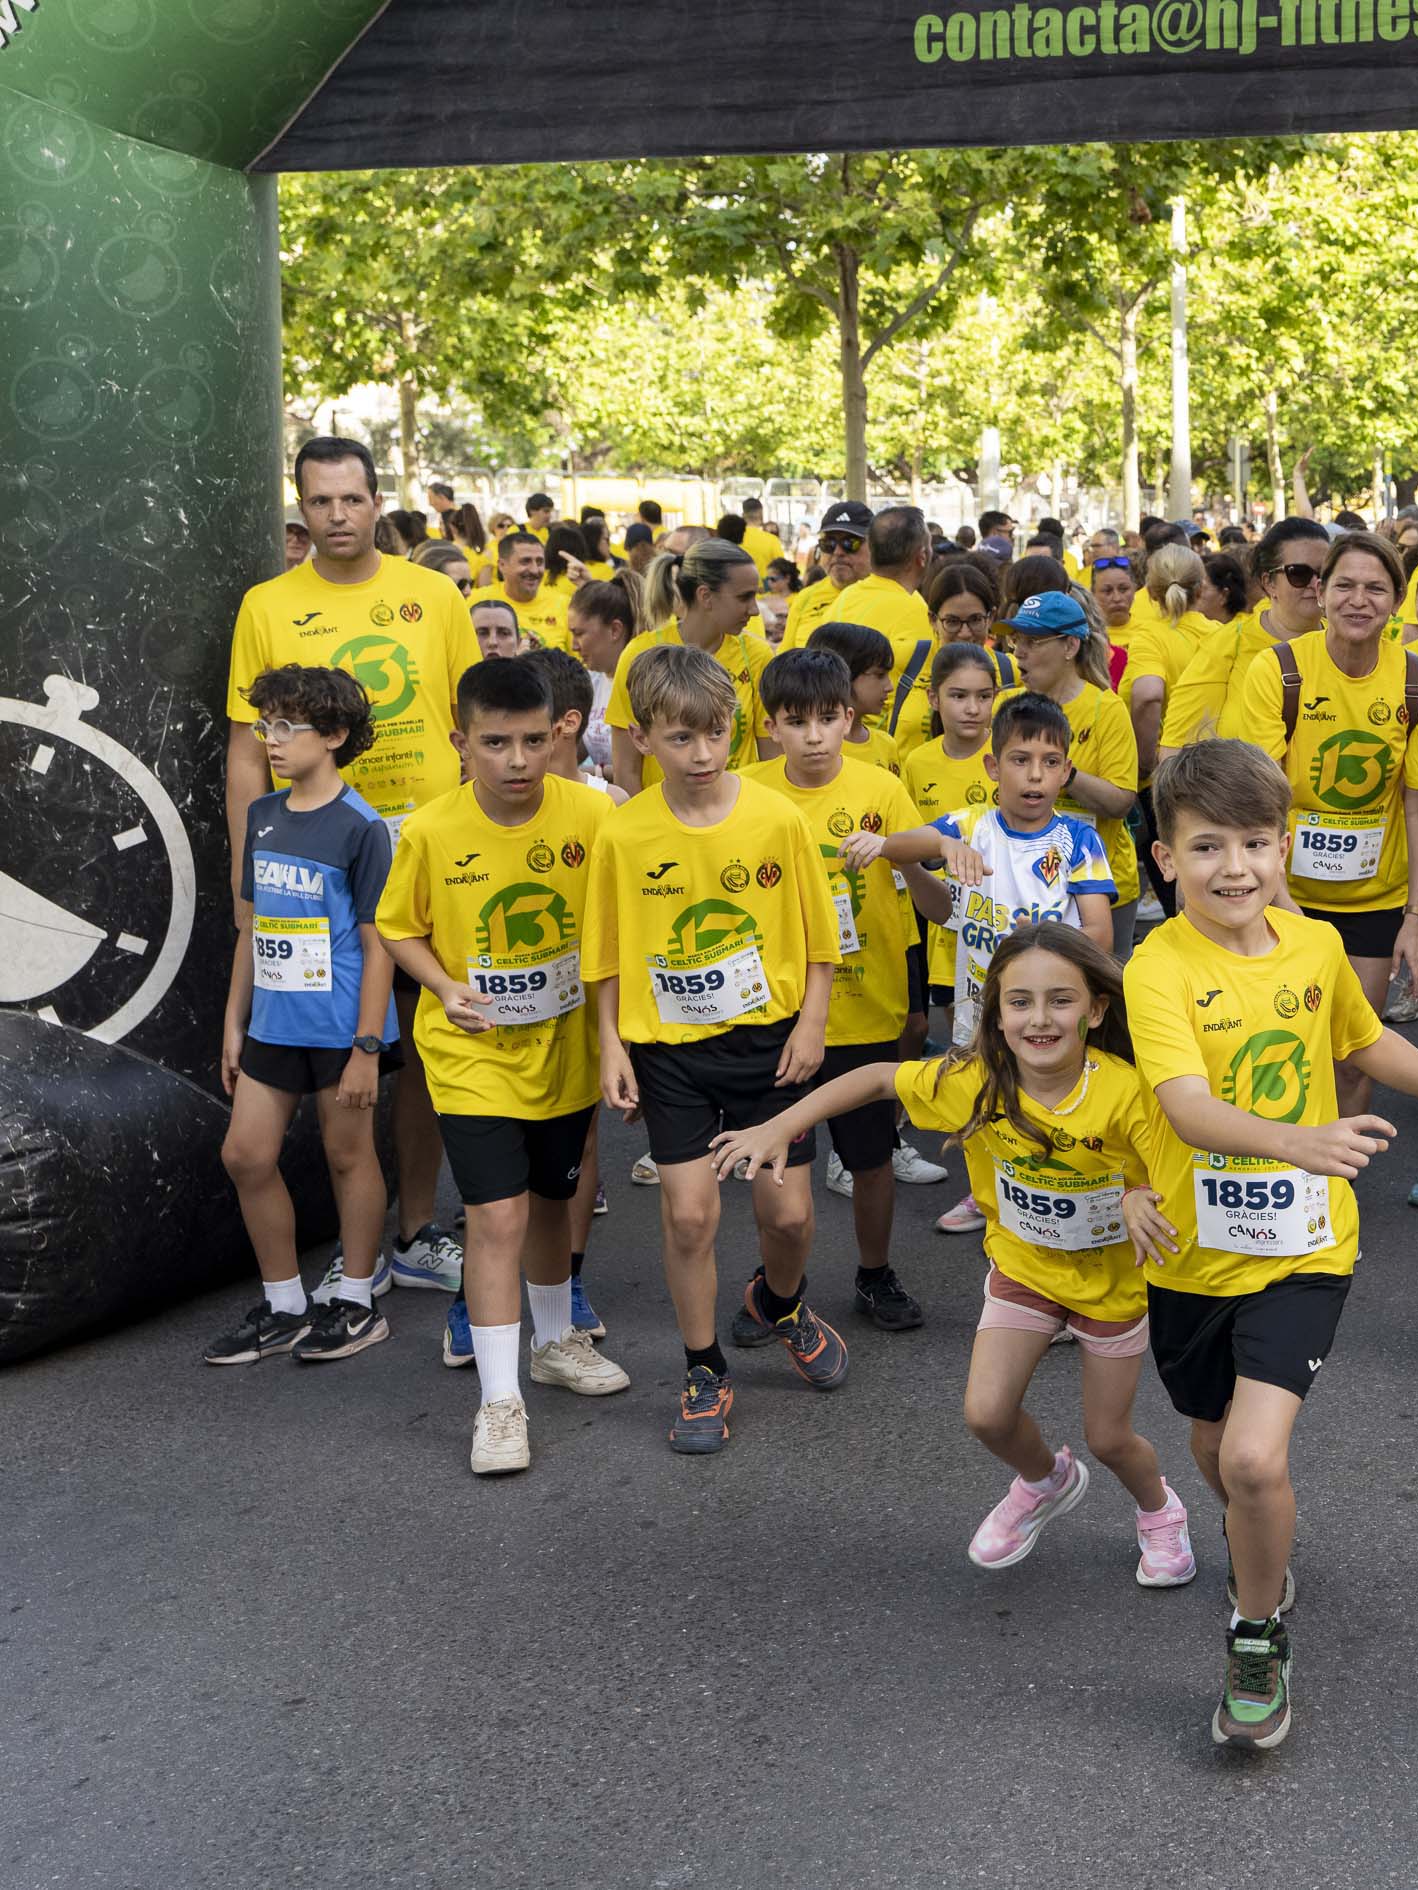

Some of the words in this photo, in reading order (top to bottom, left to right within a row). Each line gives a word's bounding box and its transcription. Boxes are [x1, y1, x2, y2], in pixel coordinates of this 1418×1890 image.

[1301, 831, 1358, 852] 1859
[497, 957, 529, 965] CELTIC
[670, 956, 703, 966] CELTIC
[474, 970, 547, 994] 1859
[655, 969, 725, 995] 1859
[1203, 1017, 1242, 1033] ENDAVANT
[1020, 1172, 1054, 1186] CELTIC
[1057, 1174, 1109, 1188] SUBMARÍ
[1000, 1176, 1077, 1219] 1859
[1202, 1178, 1295, 1211] 1859
[1226, 1209, 1277, 1221] GRÀCIES!
